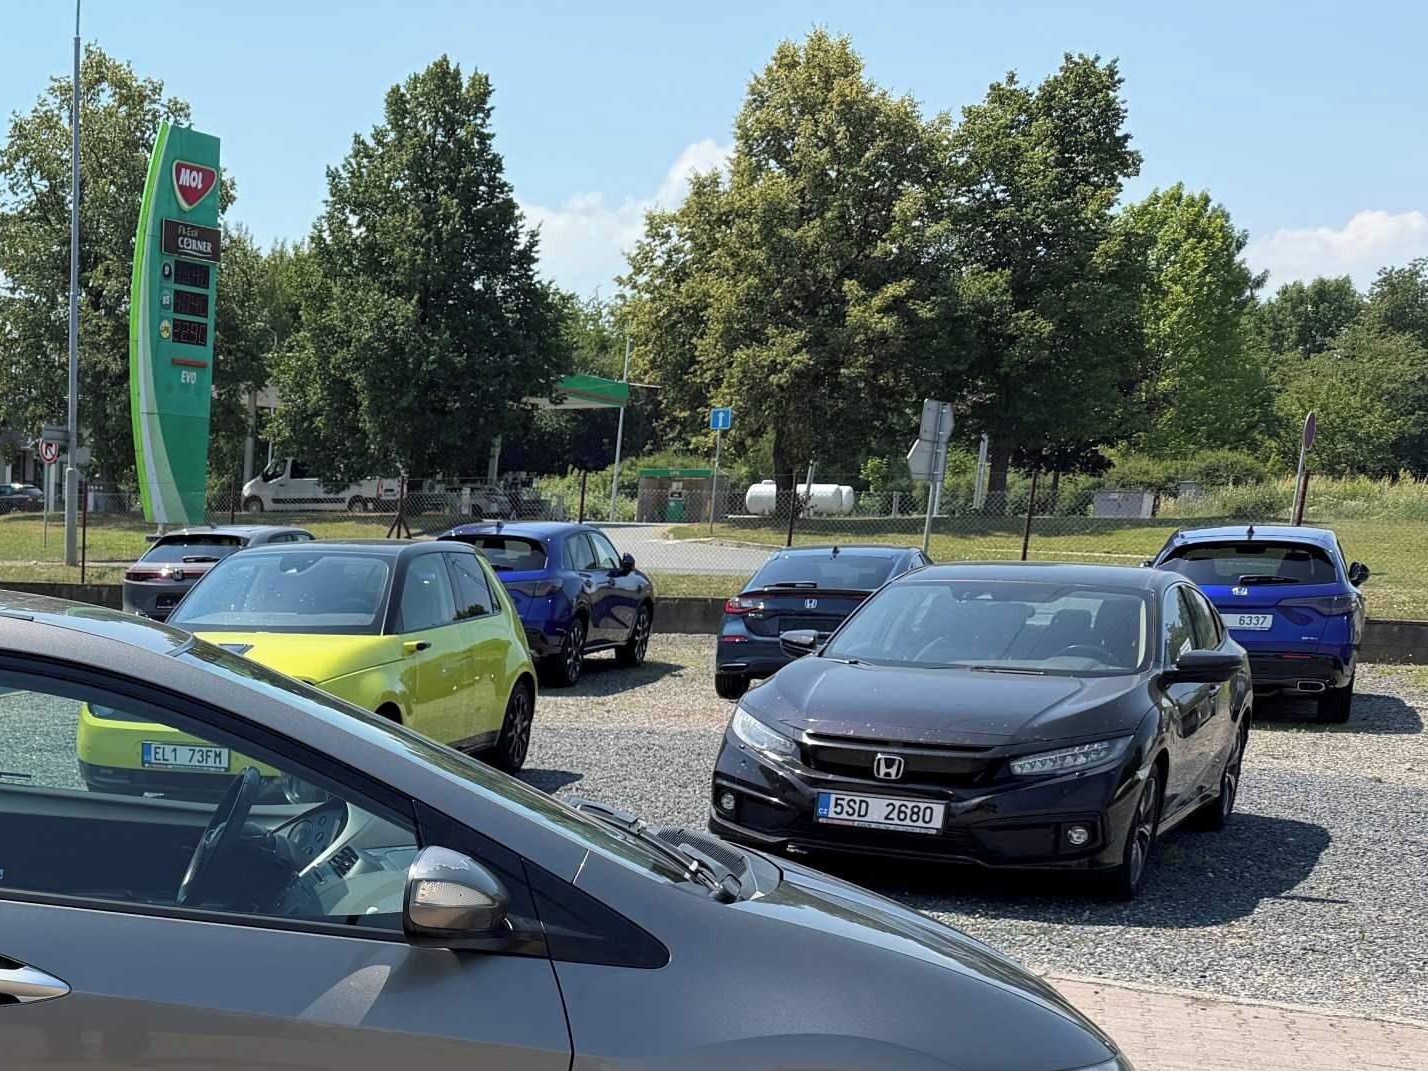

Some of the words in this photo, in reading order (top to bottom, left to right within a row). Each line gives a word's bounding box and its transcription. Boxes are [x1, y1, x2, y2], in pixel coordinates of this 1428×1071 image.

[179, 168, 202, 189] MOL
[181, 371, 196, 384] EVO
[1238, 615, 1267, 626] 6337
[153, 746, 177, 762] EL1
[188, 748, 222, 765] 73FM
[833, 798, 869, 818] 5SD
[884, 802, 934, 824] 2680
